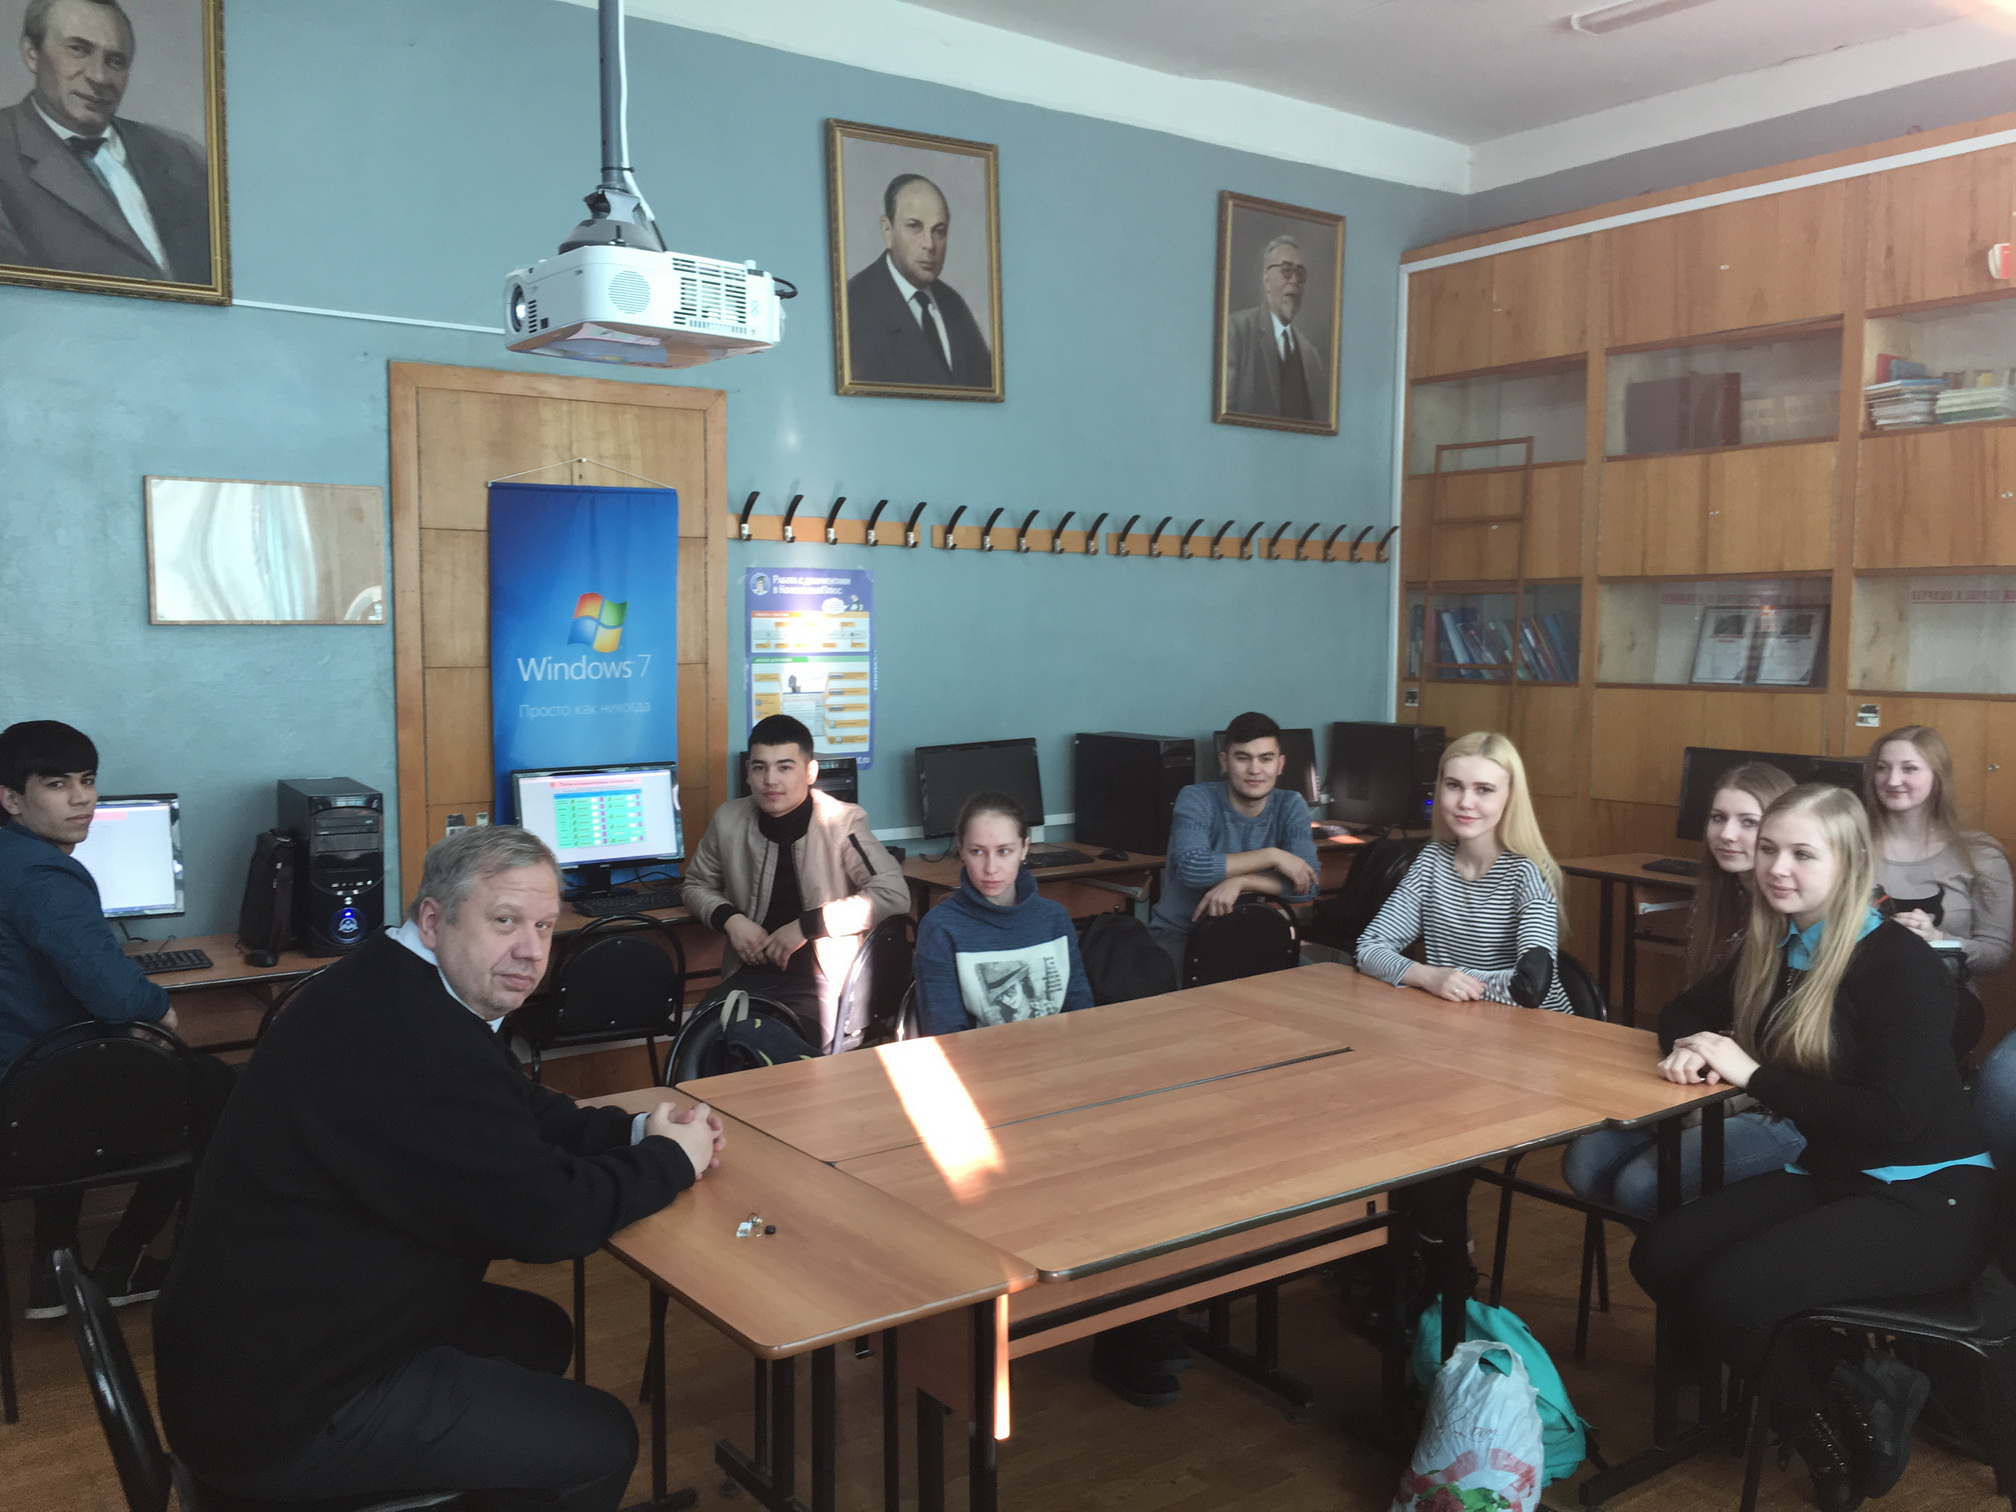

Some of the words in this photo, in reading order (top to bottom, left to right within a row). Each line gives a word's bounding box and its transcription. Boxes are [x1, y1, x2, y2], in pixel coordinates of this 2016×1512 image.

[517, 655, 633, 682] Windows
[638, 654, 652, 678] 7
[519, 704, 571, 721] Просто
[575, 704, 597, 716] как
[601, 702, 652, 715] никогда
